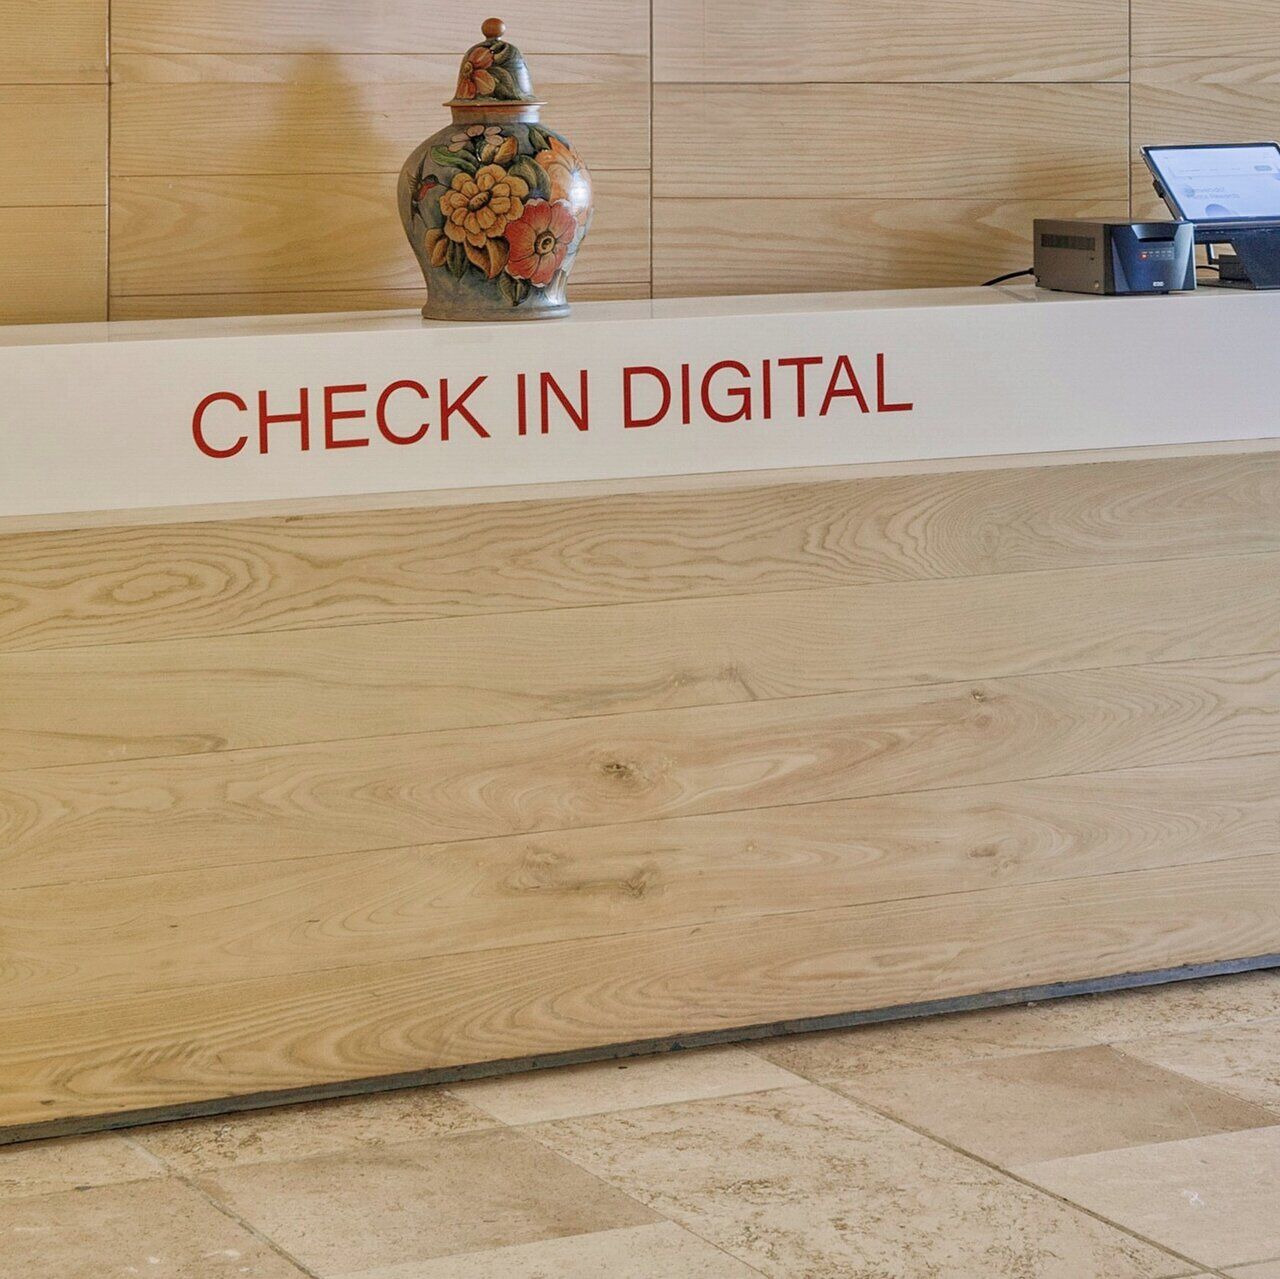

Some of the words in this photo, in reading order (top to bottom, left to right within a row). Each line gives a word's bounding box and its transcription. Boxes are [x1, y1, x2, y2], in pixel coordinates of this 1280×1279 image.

[191, 376, 491, 459] CHECK
[517, 370, 590, 436] IN
[622, 353, 914, 429] DIGITAL
